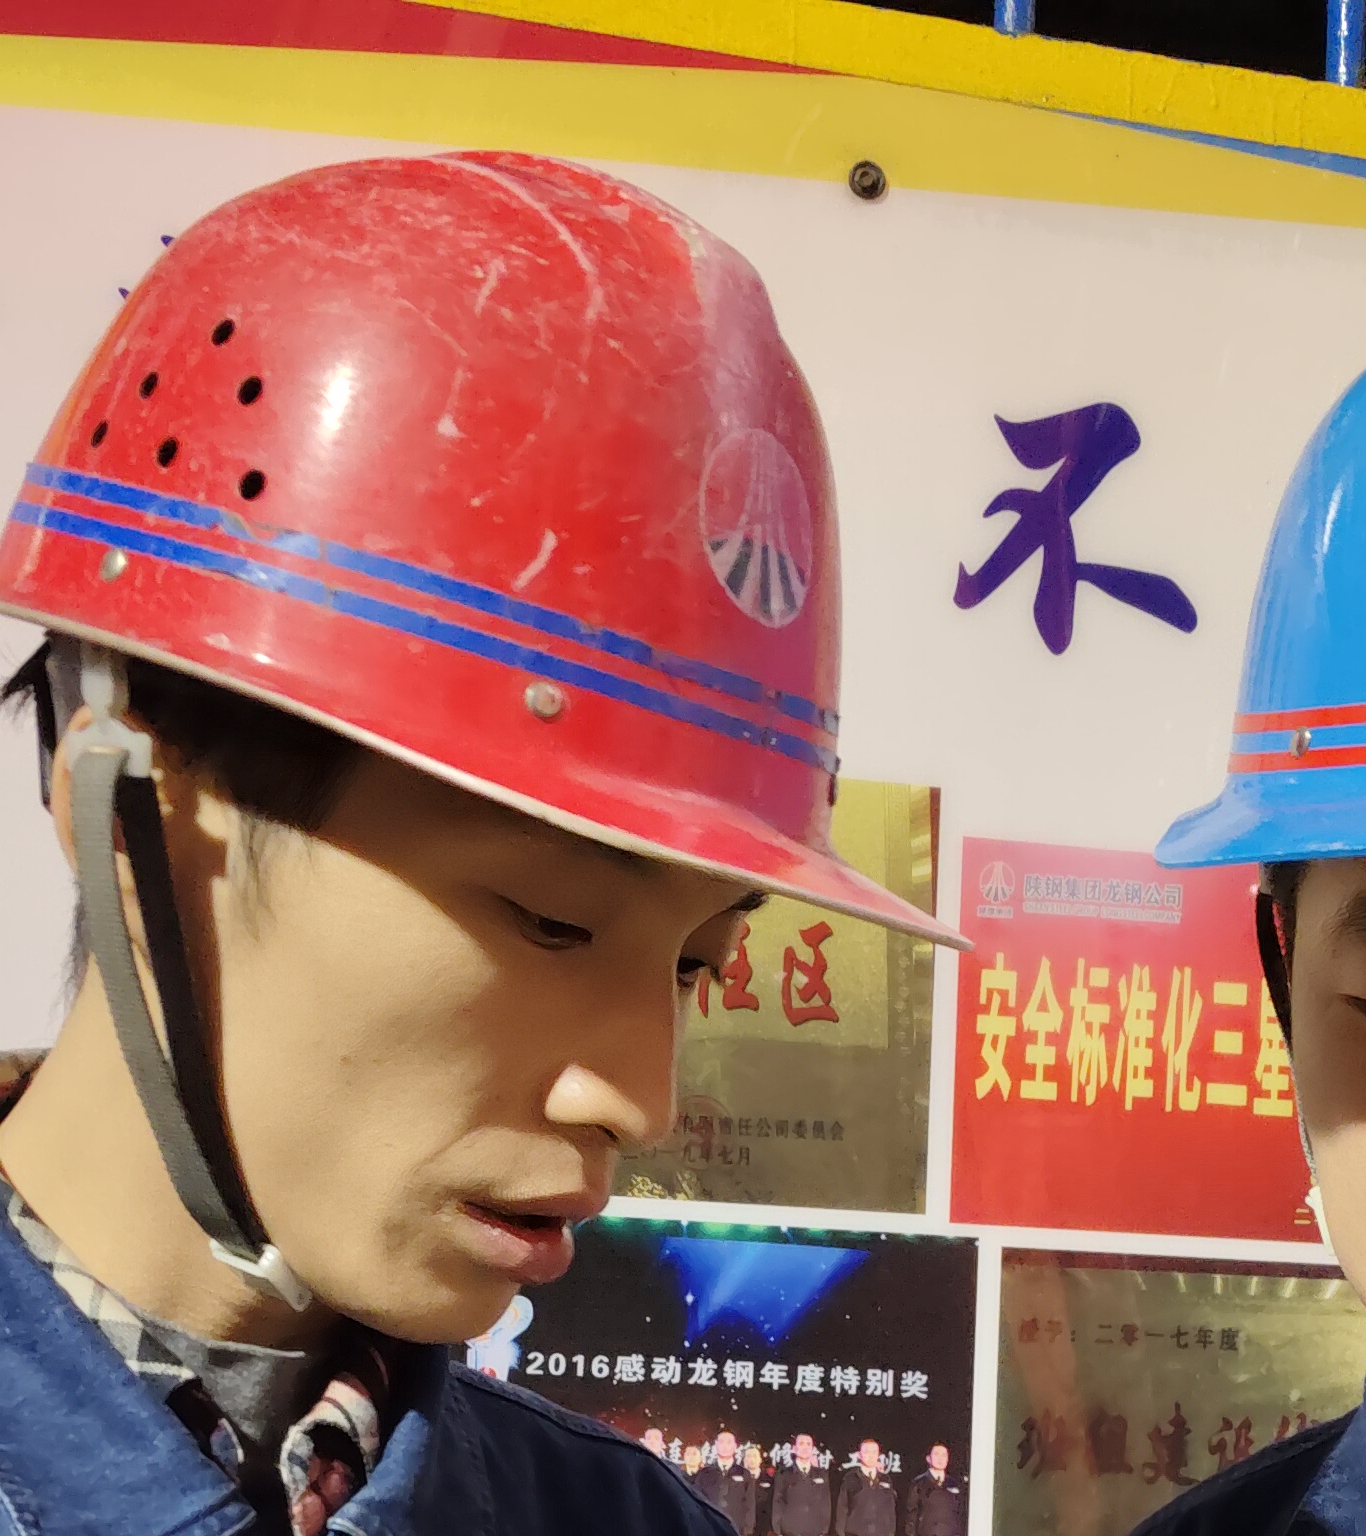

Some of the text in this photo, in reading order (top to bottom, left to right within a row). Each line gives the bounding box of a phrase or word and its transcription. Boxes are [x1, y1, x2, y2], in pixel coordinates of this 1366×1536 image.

[1023, 873, 1184, 909] 陕钢集团龙钢公司
[975, 952, 1294, 1118] 安全标准化三星
[525, 1351, 930, 1401] 2016感动龙钢年度特别奖
